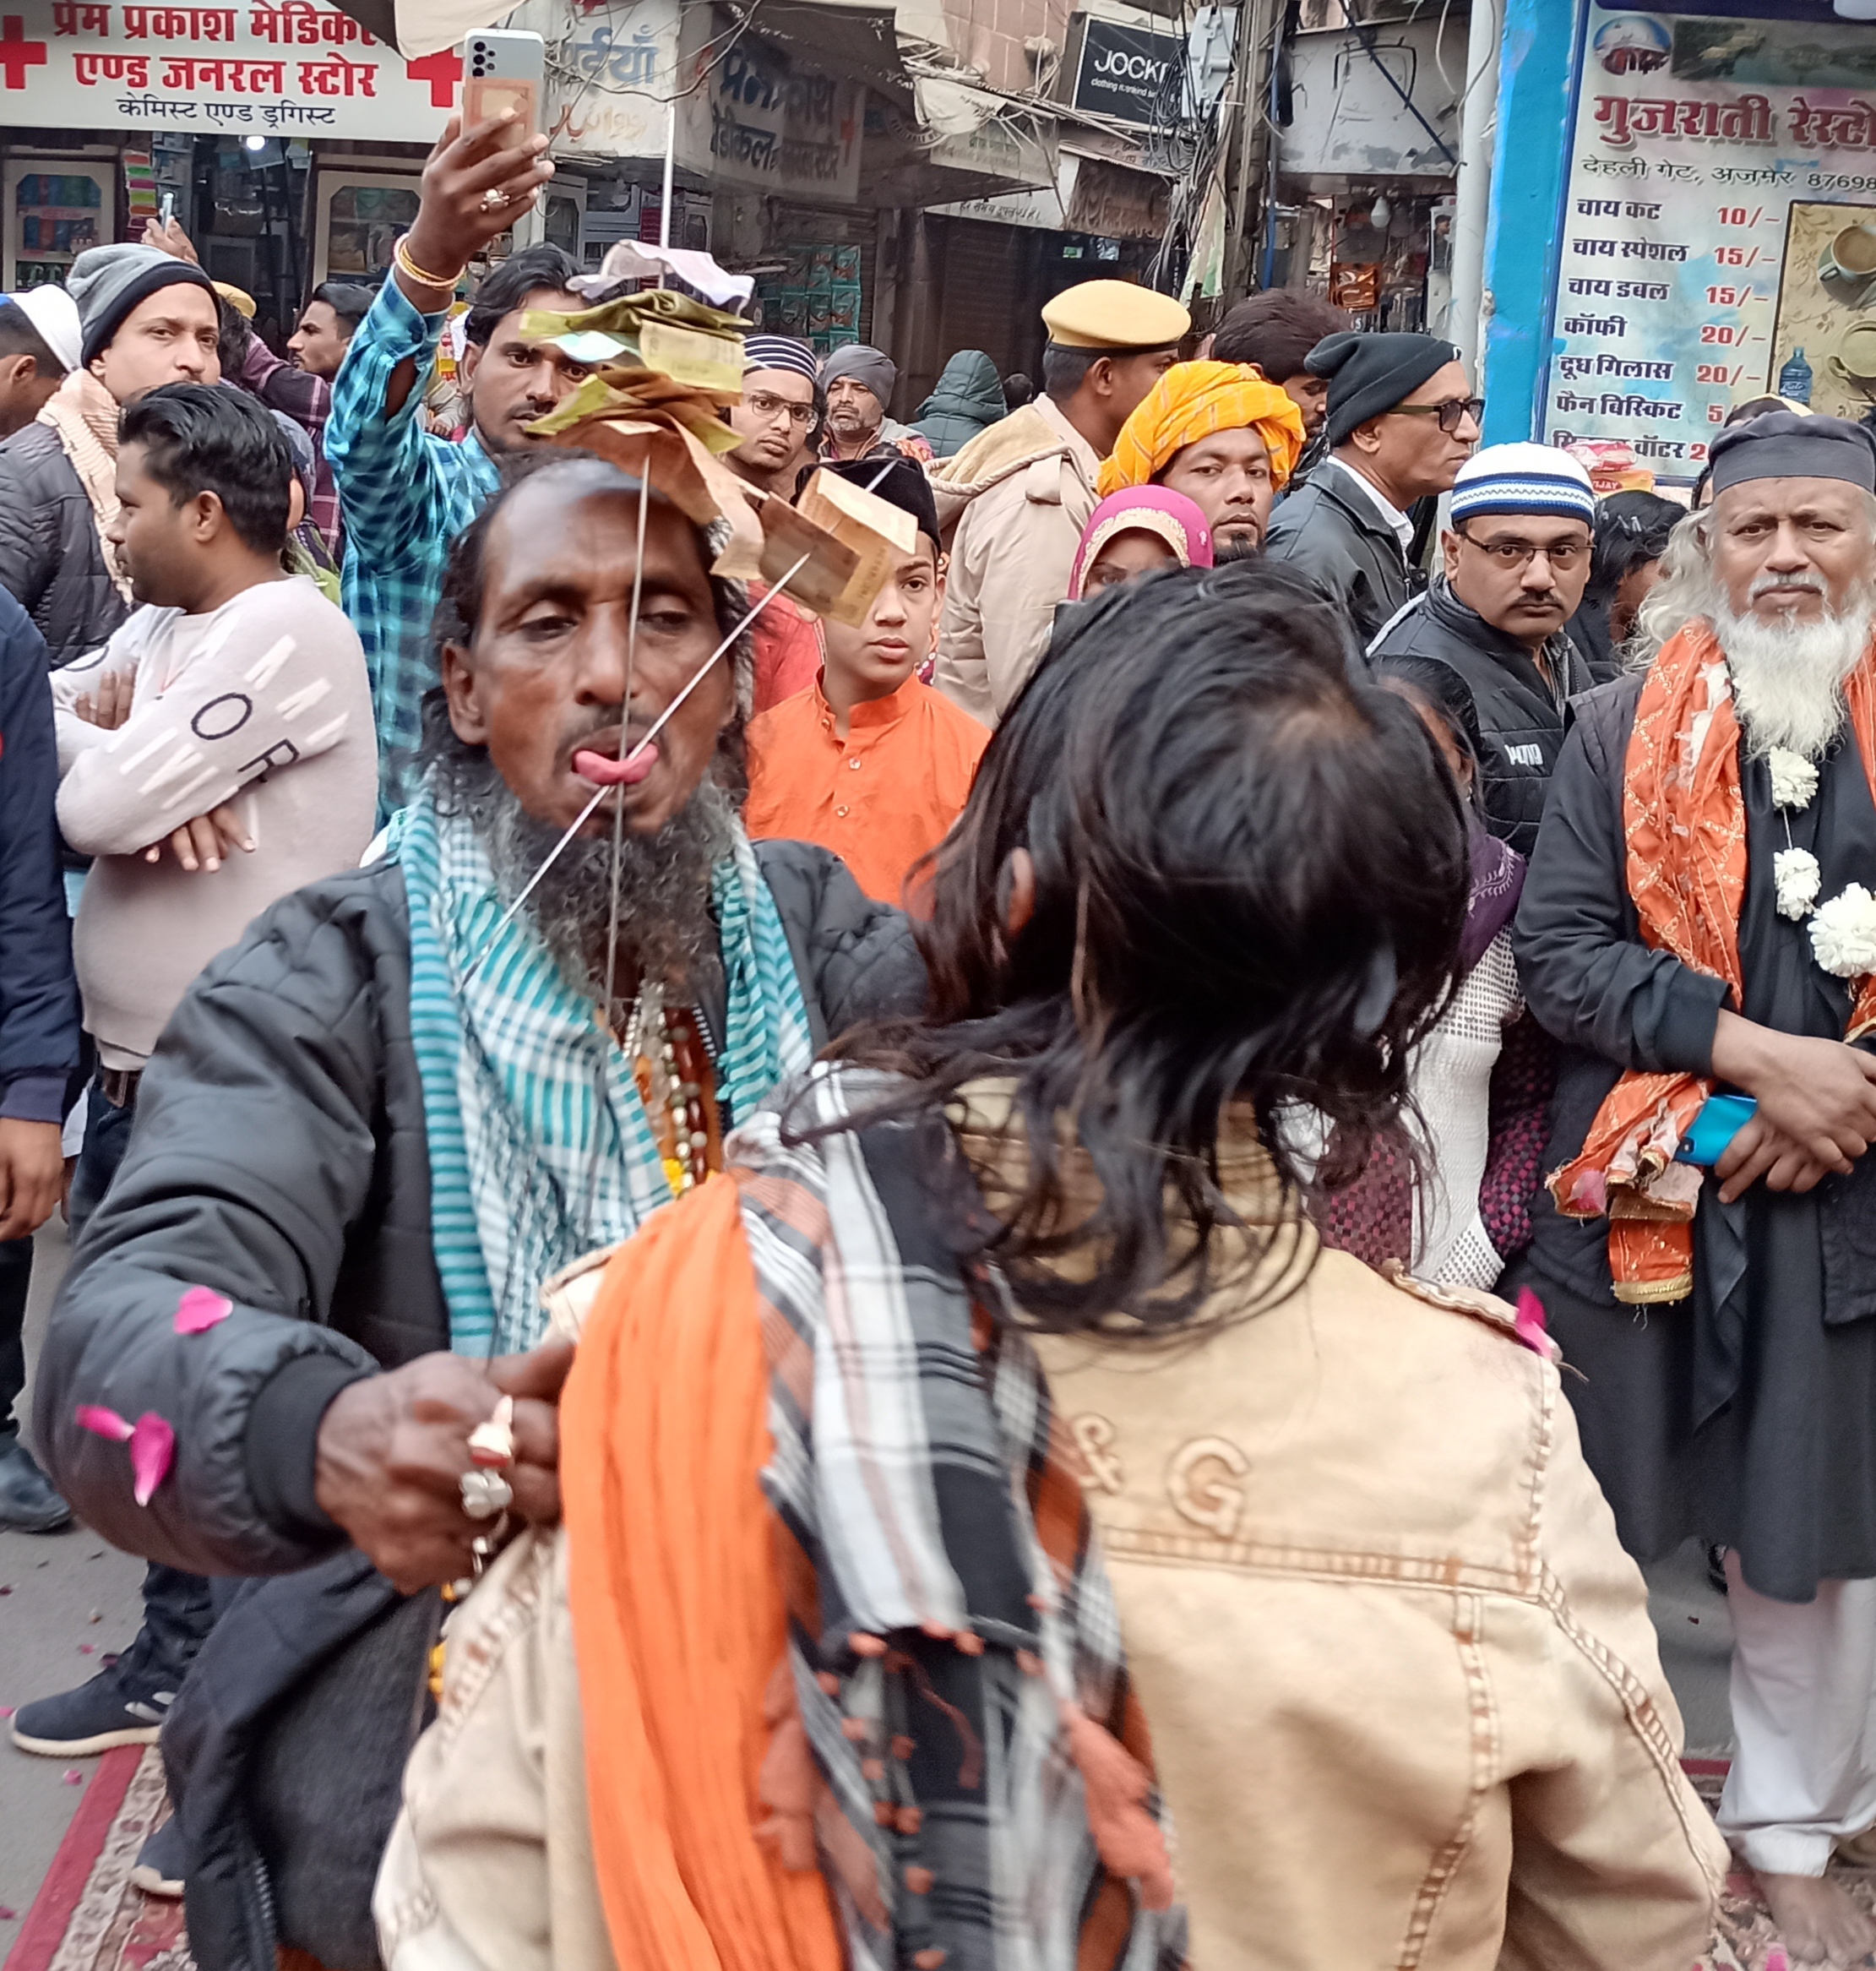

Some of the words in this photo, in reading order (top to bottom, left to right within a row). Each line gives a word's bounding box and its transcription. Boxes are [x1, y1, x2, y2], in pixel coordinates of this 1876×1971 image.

[52, 0, 111, 36] प्रेम
[122, 5, 238, 41] प्रकाश
[73, 53, 151, 88] एण्ड
[160, 57, 286, 93] जनरल
[296, 52, 379, 97] स्टोर
[1094, 49, 1171, 85] JOCK
[115, 91, 198, 119] केमिस्ट
[203, 103, 253, 127] एण्ड
[1594, 94, 1772, 144] गुजराती
[1582, 155, 1646, 179] देहली
[1711, 166, 1792, 184] अजमेर
[1808, 174, 1876, 190] 87698
[1577, 199, 1620, 217] चाय
[1625, 201, 1662, 220] कट
[1716, 206, 1780, 229] 10/-
[1573, 238, 1617, 258] चाय
[1620, 237, 1689, 262] स्पेशल
[1714, 247, 1776, 268] 15/-
[1569, 278, 1612, 297] चाय
[1617, 280, 1669, 300] डबल
[1705, 286, 1769, 308] 15/-
[1564, 313, 1627, 337] कॉफी
[1701, 325, 1766, 347] 20/-
[1560, 356, 1592, 380] दूध
[1596, 354, 1673, 379] गिलास
[1697, 365, 1761, 386] 20/-
[1557, 390, 1596, 414] फैन
[1599, 395, 1683, 419] बिस्किट
[1634, 435, 1686, 459] वॉटर
